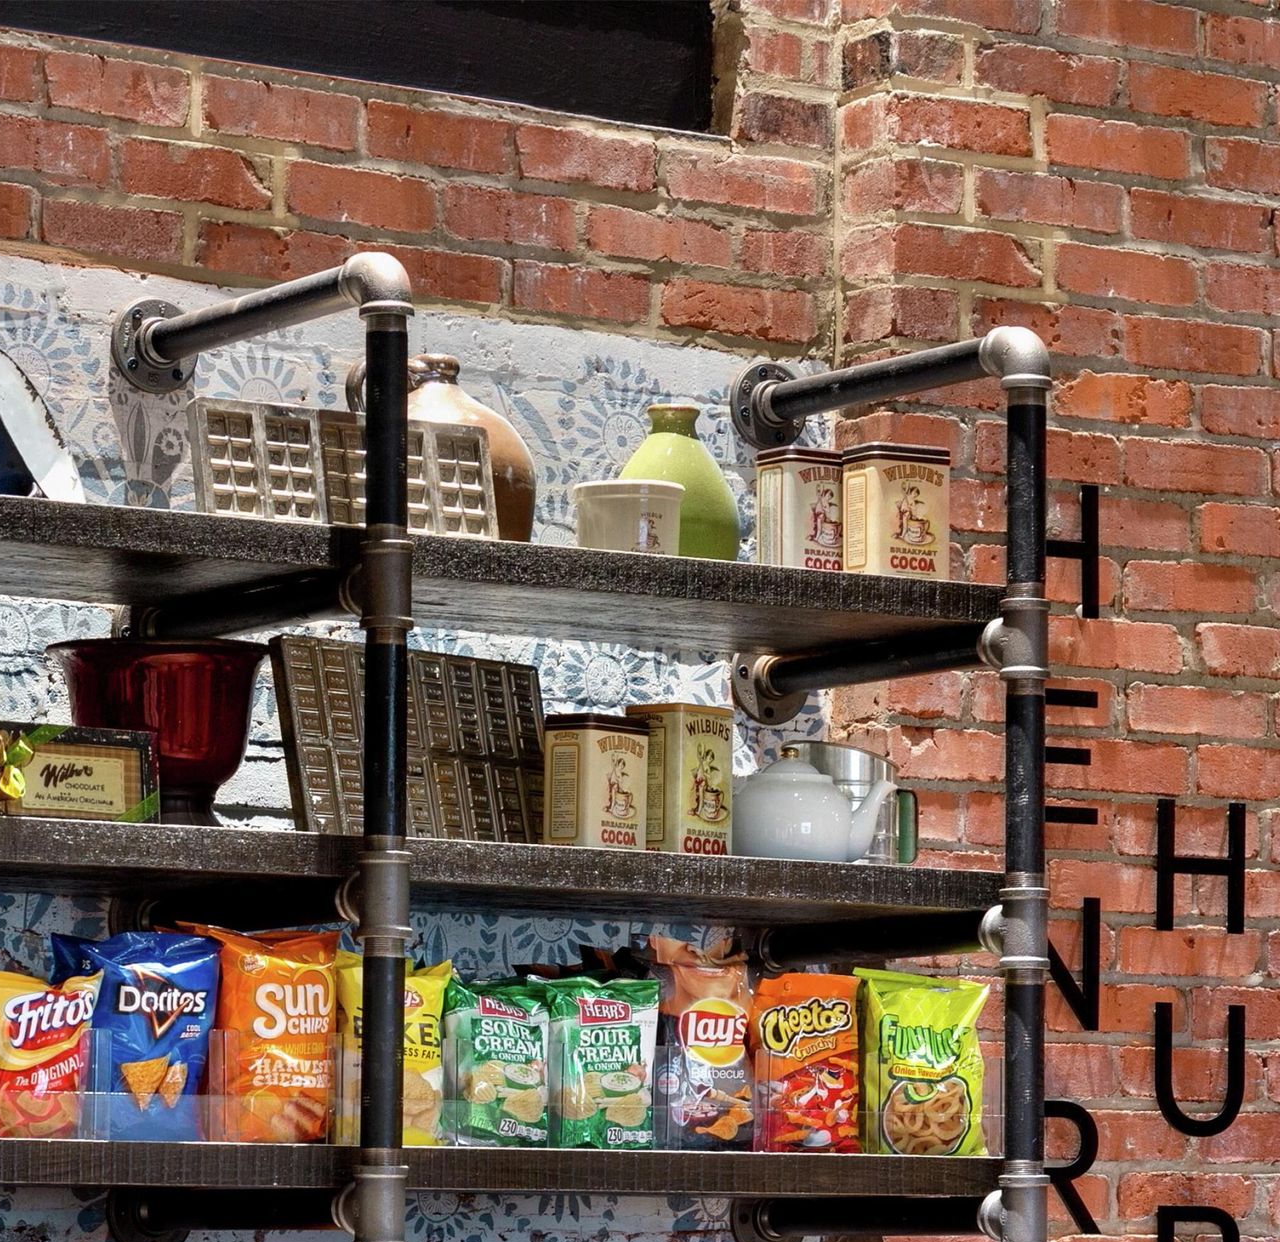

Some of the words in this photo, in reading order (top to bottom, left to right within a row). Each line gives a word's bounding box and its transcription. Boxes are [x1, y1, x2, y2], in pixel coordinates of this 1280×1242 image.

[883, 464, 945, 487] WILBUR'S
[889, 547, 938, 557] BREAKFAST
[890, 555, 936, 572] COCOA
[685, 718, 731, 742] WILBUR'S
[596, 735, 645, 759] WILBUR'S
[64, 783, 105, 792] CHOCOLATE
[601, 820, 638, 830] BREAKFAST
[686, 829, 727, 839] BREAKFAST
[601, 829, 637, 846] COCOA
[683, 836, 728, 855] COCOA
[118, 985, 208, 1014] Doritos
[253, 983, 331, 1039] Sun
[583, 1000, 626, 1019] HERR'S
[287, 1016, 330, 1035] CHIPS
[480, 1018, 534, 1039] SOUR
[688, 1013, 748, 1047] Lay's
[763, 997, 850, 1055] Cheetos
[474, 1036, 542, 1058] CREAM
[579, 1029, 632, 1047] SOUR
[404, 1046, 419, 1058] ESS
[421, 1050, 436, 1060] FAT
[498, 1053, 526, 1063] ONION
[573, 1046, 640, 1064] CREAM
[792, 1036, 838, 1061] Crunchy
[30, 1053, 85, 1086] ORIGINAL
[594, 1063, 622, 1072] ONION
[501, 1118, 517, 1135] 230
